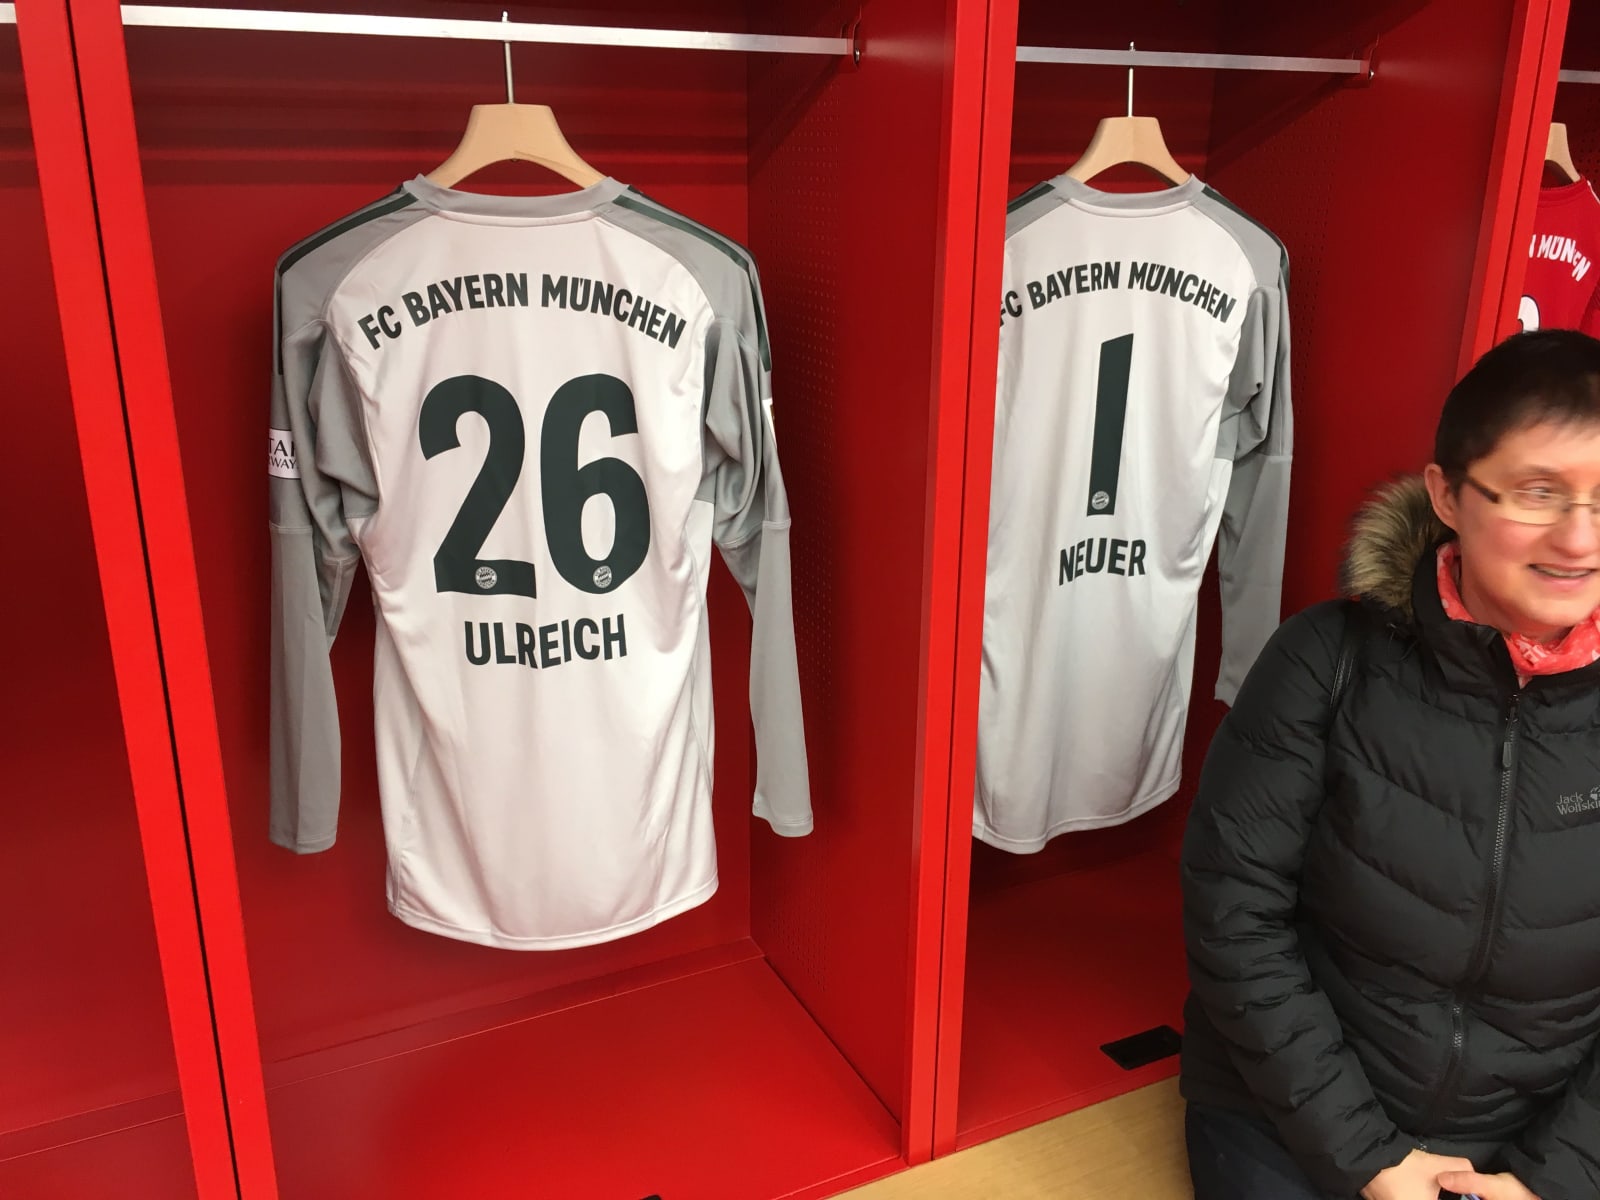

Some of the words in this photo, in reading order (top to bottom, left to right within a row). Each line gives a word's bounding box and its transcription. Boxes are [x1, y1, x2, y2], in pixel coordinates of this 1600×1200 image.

[357, 310, 402, 350] FC
[402, 273, 528, 328] BAYERN
[541, 273, 687, 350] MÜNCHEN
[1026, 261, 1121, 310] BAYERN
[1127, 261, 1237, 323] MÜNCHEN
[1087, 333, 1134, 517] 1
[418, 373, 651, 600] 26
[1058, 537, 1147, 586] NEUER
[464, 613, 628, 669] ULREICH
[1556, 792, 1584, 805] Jack
